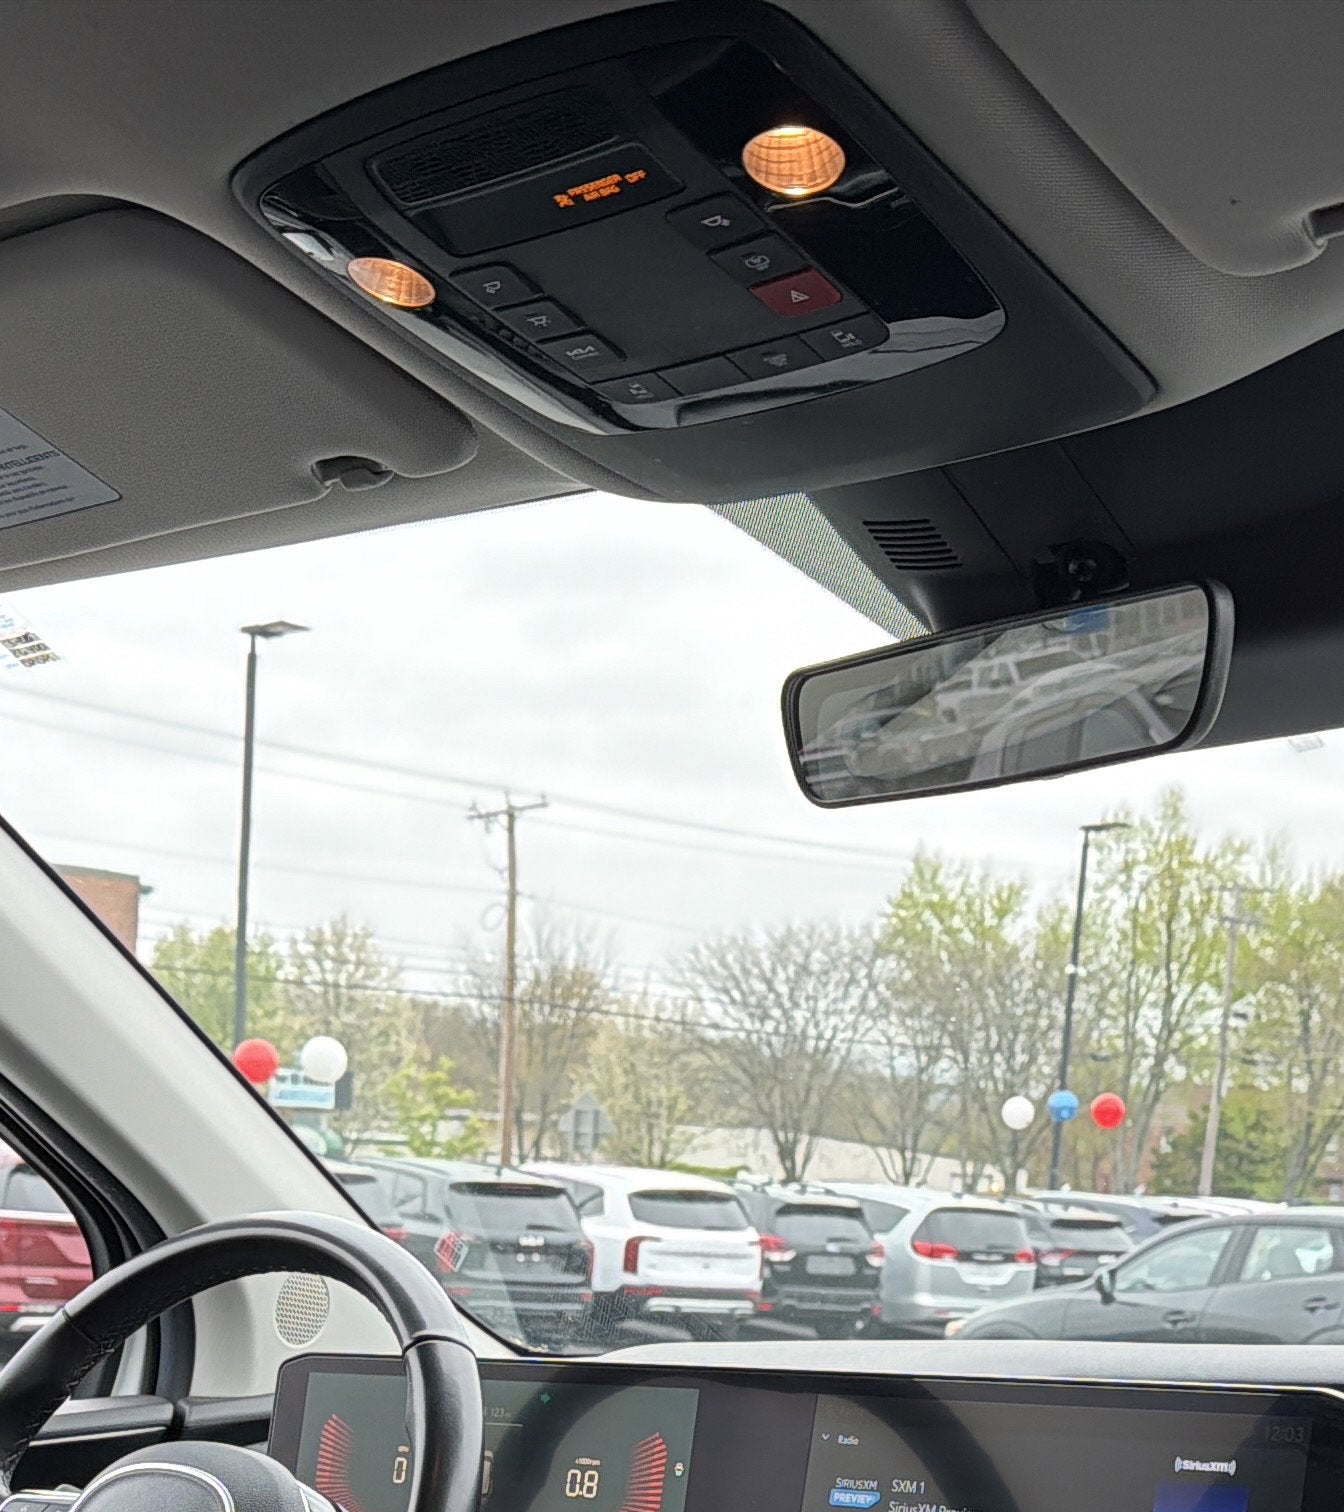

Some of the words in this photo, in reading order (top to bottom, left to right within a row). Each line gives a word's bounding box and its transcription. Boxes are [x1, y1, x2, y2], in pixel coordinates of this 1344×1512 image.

[624, 169, 647, 183] OFF
[837, 1435, 859, 1446] Radio
[393, 1456, 408, 1484] 0
[566, 1469, 599, 1498] 0.8
[891, 1479, 916, 1494] SXM
[919, 1481, 926, 1495] 1
[833, 1492, 874, 1504] PREVIEW
